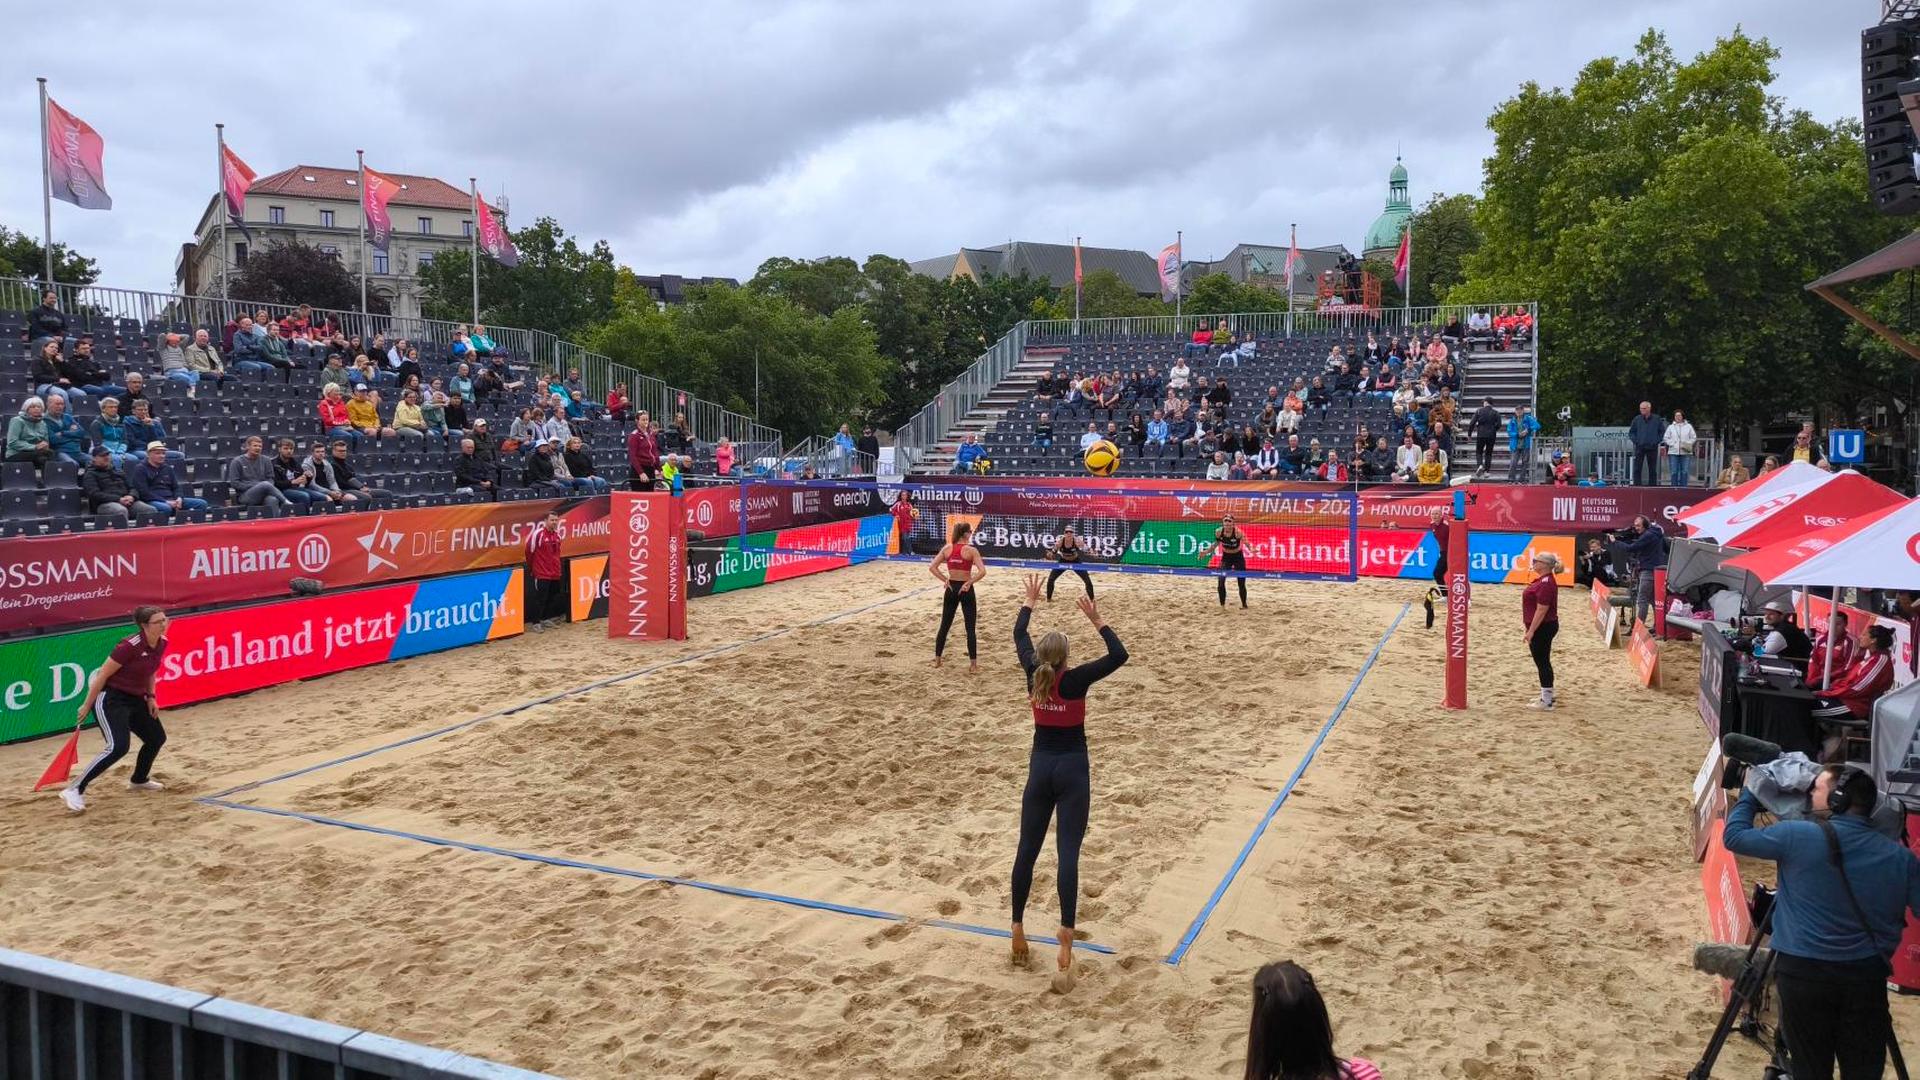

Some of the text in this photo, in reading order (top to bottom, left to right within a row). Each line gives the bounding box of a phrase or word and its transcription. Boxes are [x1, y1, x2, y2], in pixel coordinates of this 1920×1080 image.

[1838, 434, 1860, 458] U
[833, 488, 871, 507] enercity
[1249, 498, 1315, 514] FINALS
[1370, 503, 1450, 517] HANNOVR
[1552, 497, 1577, 521] DVV
[1582, 498, 1617, 506] DEUTSCHER
[1582, 506, 1619, 514] VOLLEYBALL
[411, 529, 446, 557] DIE
[451, 522, 522, 552] FINALS
[1130, 531, 1170, 554] die
[1360, 541, 1428, 569] jetzt
[189, 545, 291, 579] Allianz
[628, 499, 650, 636] ROSSMANN
[669, 536, 678, 602] ROSSMANN
[715, 553, 737, 577] die
[578, 573, 611, 602] Die
[324, 609, 396, 659] jetzt
[404, 591, 516, 635] braucht.
[1452, 573, 1466, 659] ROSSMANN
